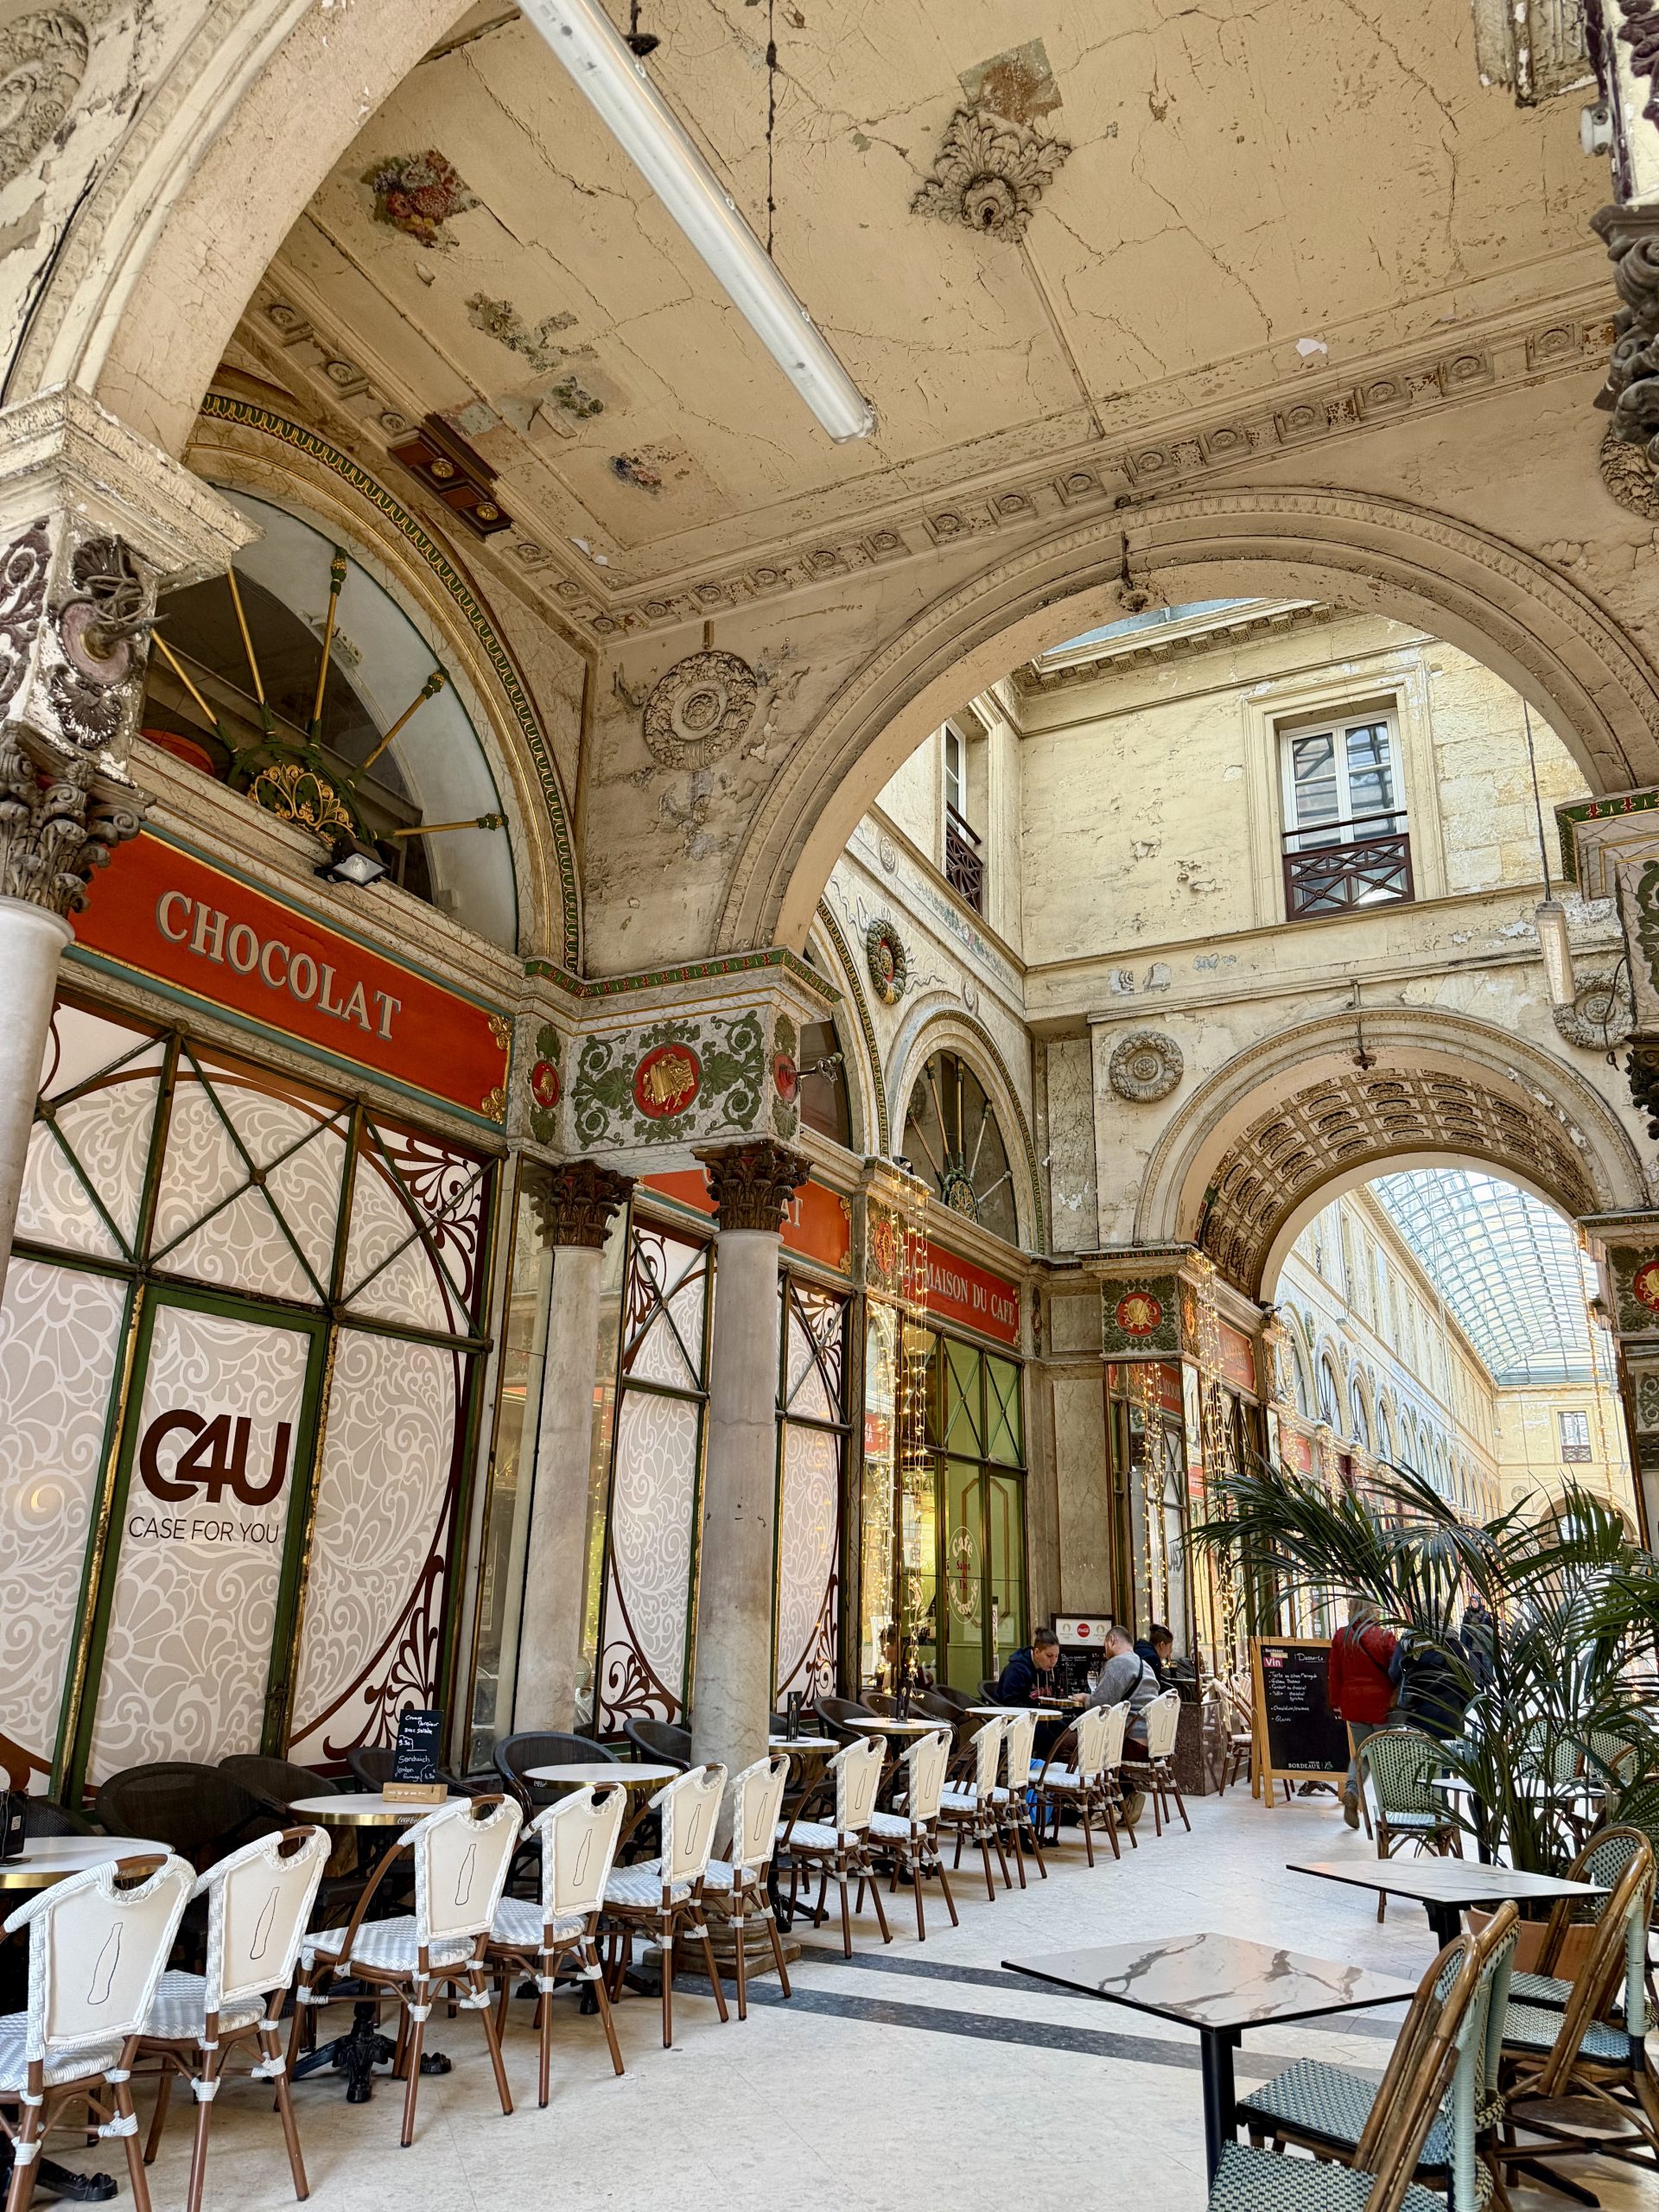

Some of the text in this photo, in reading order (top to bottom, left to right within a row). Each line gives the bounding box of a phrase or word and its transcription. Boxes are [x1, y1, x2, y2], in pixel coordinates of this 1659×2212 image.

[157, 891, 401, 1040] CHOCOLAT
[922, 1259, 968, 1304] MAISON
[972, 1283, 987, 1313] DU
[140, 1409, 292, 1506] C4U
[129, 1516, 279, 1543] CASE FOR YOU
[952, 1535, 973, 1558] Café
[1265, 1657, 1281, 1667] Vin
[398, 1755, 430, 1764] Sandwich
